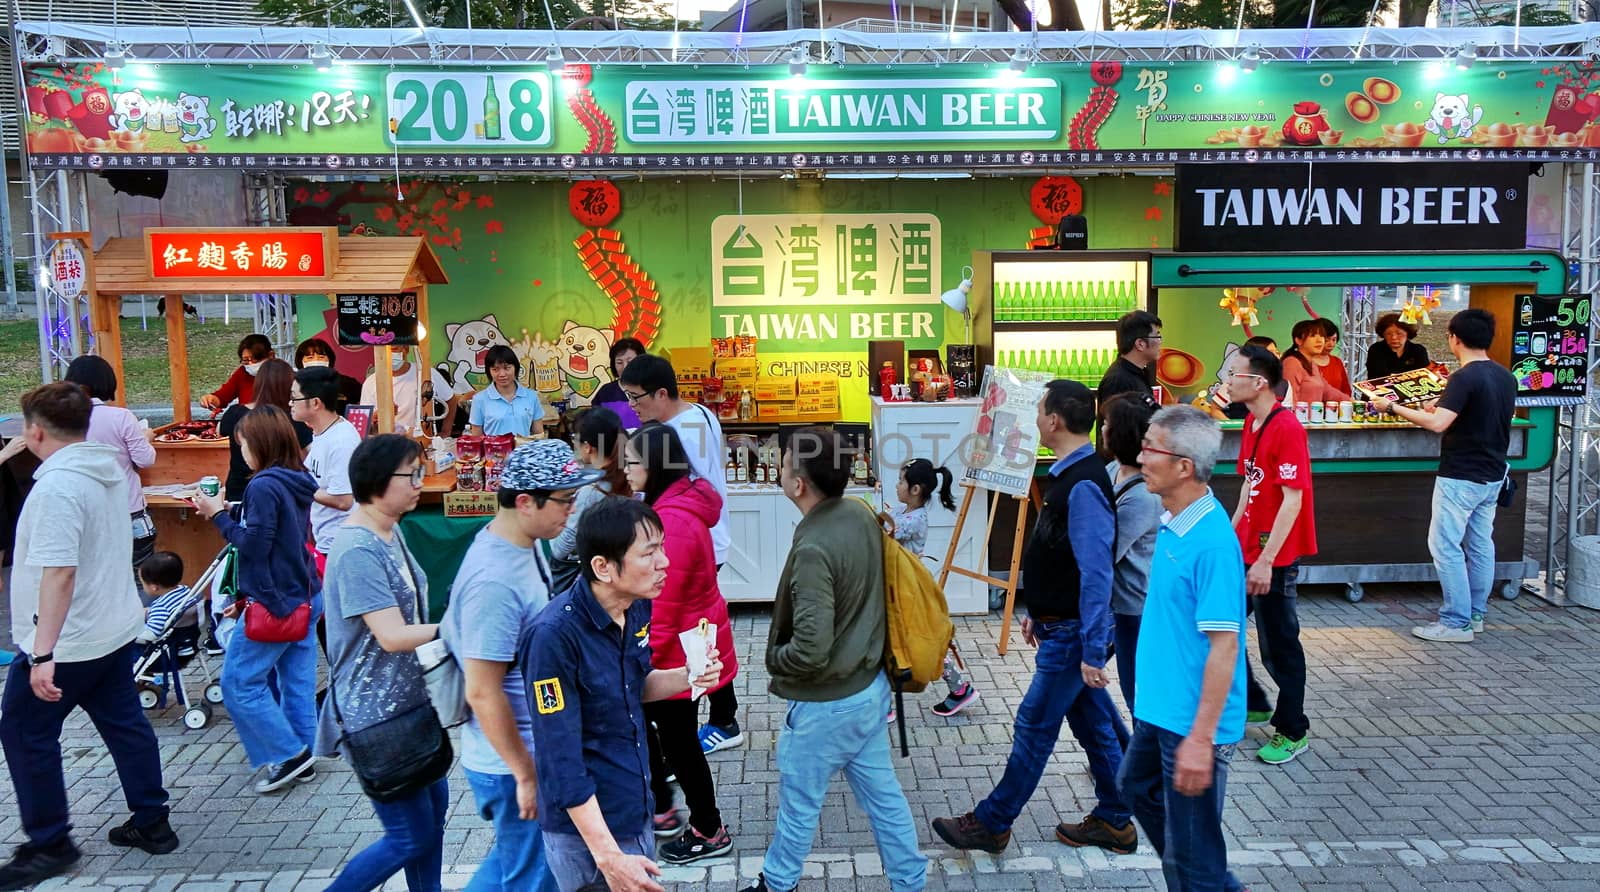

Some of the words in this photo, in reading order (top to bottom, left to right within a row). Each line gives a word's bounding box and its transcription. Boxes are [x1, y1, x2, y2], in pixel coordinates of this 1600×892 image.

[782, 94, 926, 127] TAIWAN
[942, 93, 1047, 126] BEER
[1156, 113, 1185, 122] HAPPY
[1188, 113, 1226, 122] CHINESE
[1228, 113, 1249, 122] NEW
[1250, 112, 1276, 122] YEAR
[1195, 187, 1363, 226] TAIWAN
[1379, 187, 1500, 225] BEER
[162, 241, 288, 271] 紅麴香腸
[381, 295, 415, 317] 100
[1557, 298, 1590, 327] 50
[719, 312, 837, 340] TAIWAN
[849, 311, 936, 339] BEER
[1561, 336, 1586, 355] 150
[535, 367, 557, 376] TAIWAN
[768, 360, 852, 378] CHINESE
[1554, 367, 1575, 385] 100
